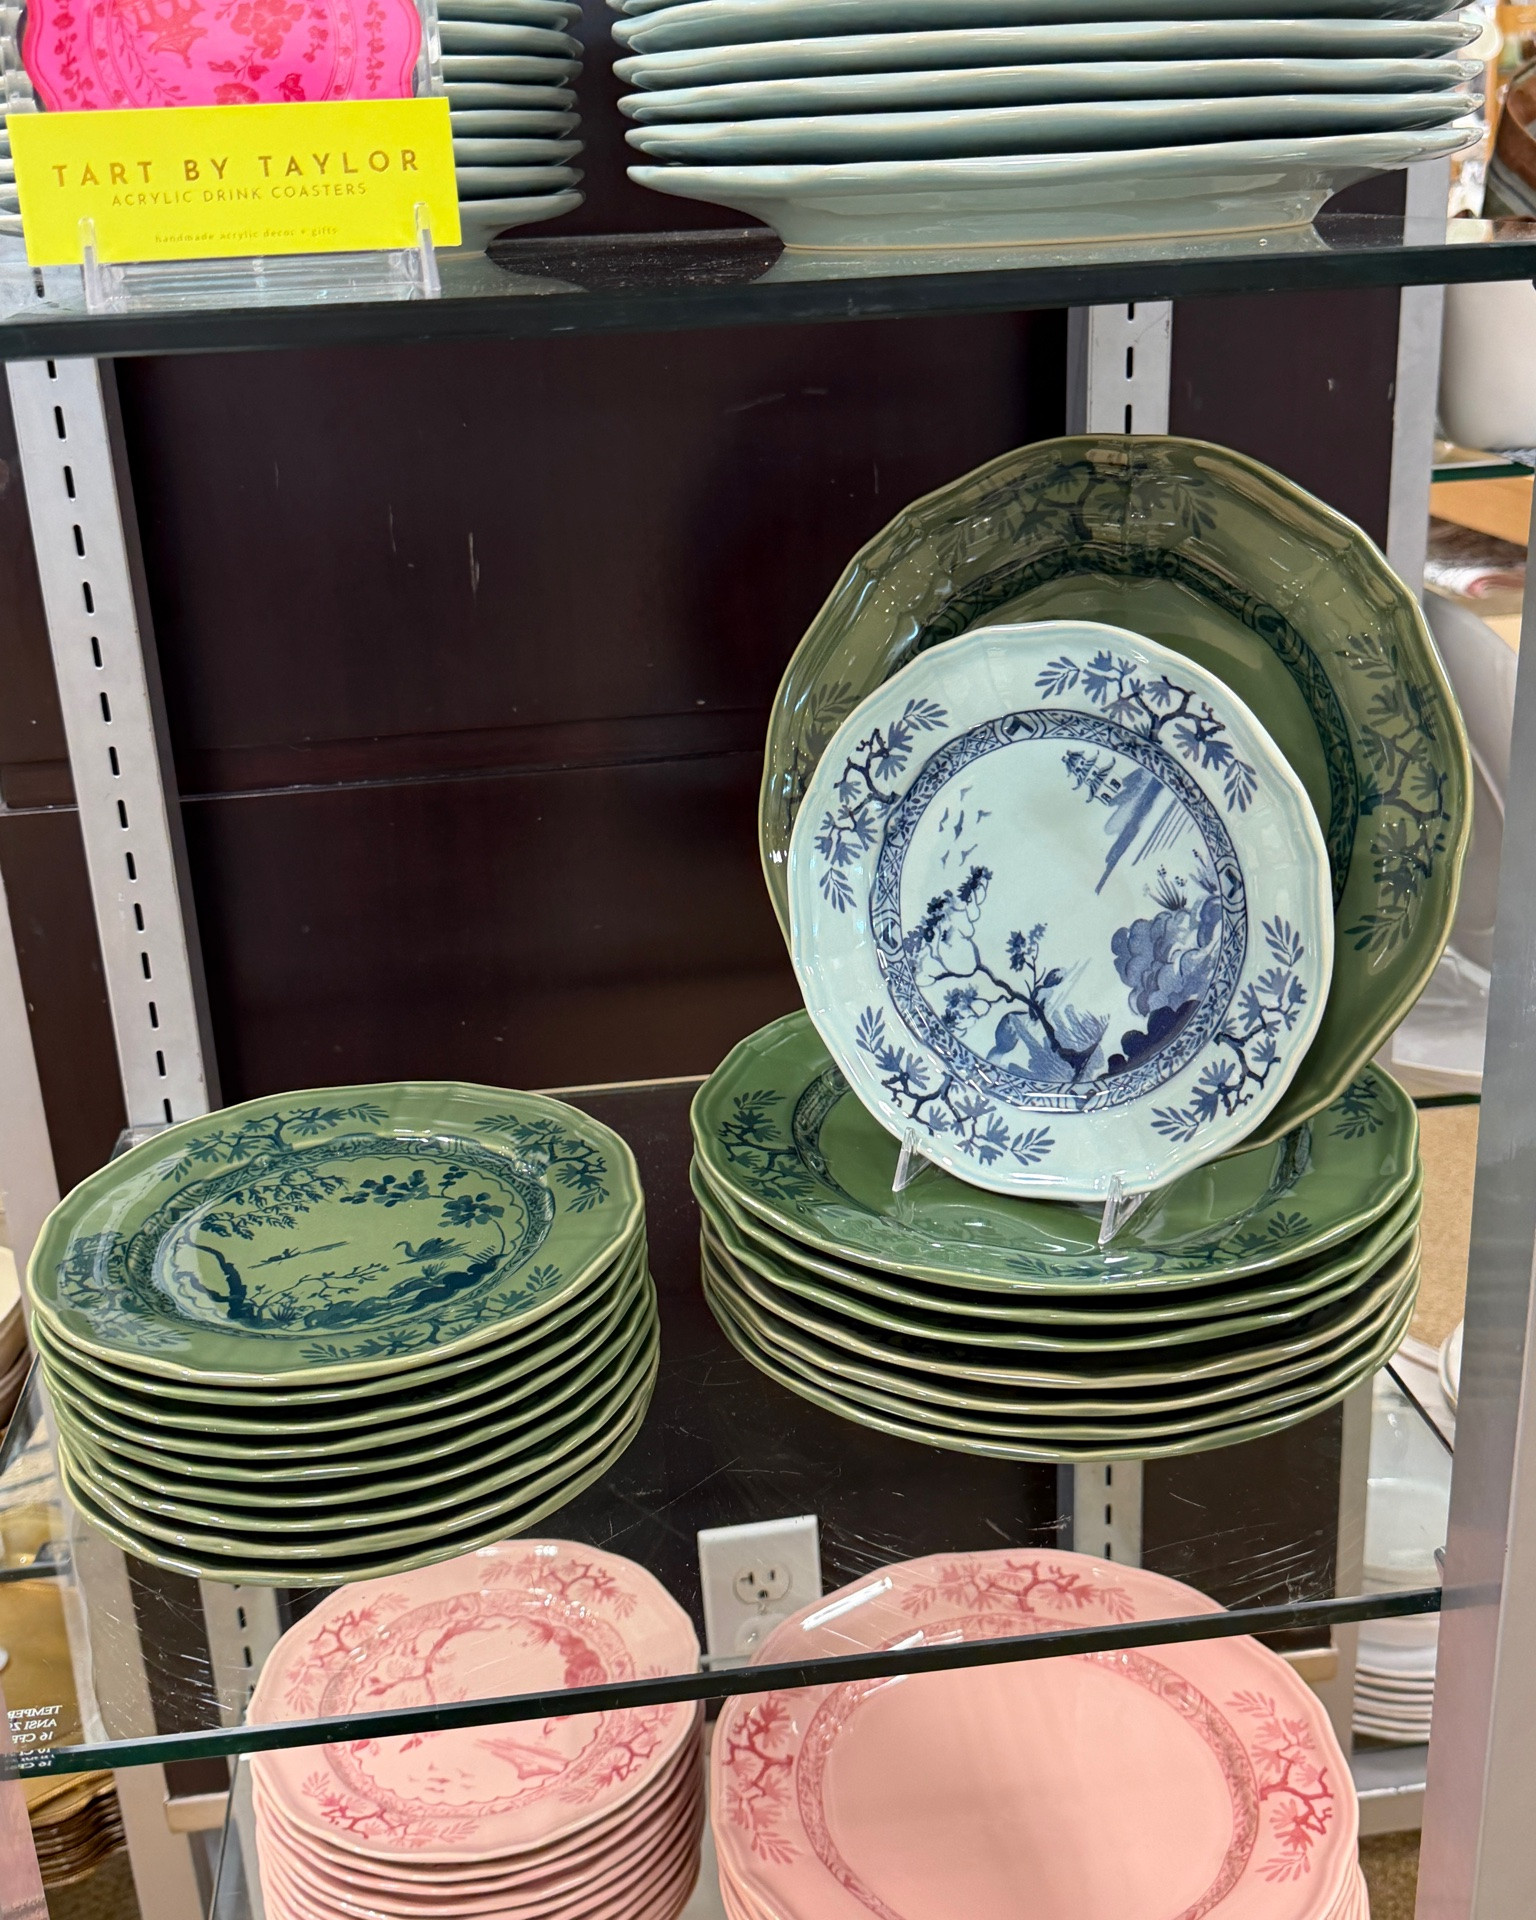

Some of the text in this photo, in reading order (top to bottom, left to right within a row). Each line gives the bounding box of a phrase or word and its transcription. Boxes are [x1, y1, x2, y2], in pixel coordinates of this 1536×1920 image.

[52, 149, 418, 188] TART BY TAYLOR
[112, 183, 367, 207] ACRYLIC DRINK COASTERS
[155, 231, 215, 243] handmade
[219, 228, 259, 242] acrylic
[263, 227, 296, 239] decor
[311, 225, 338, 238] gifts
